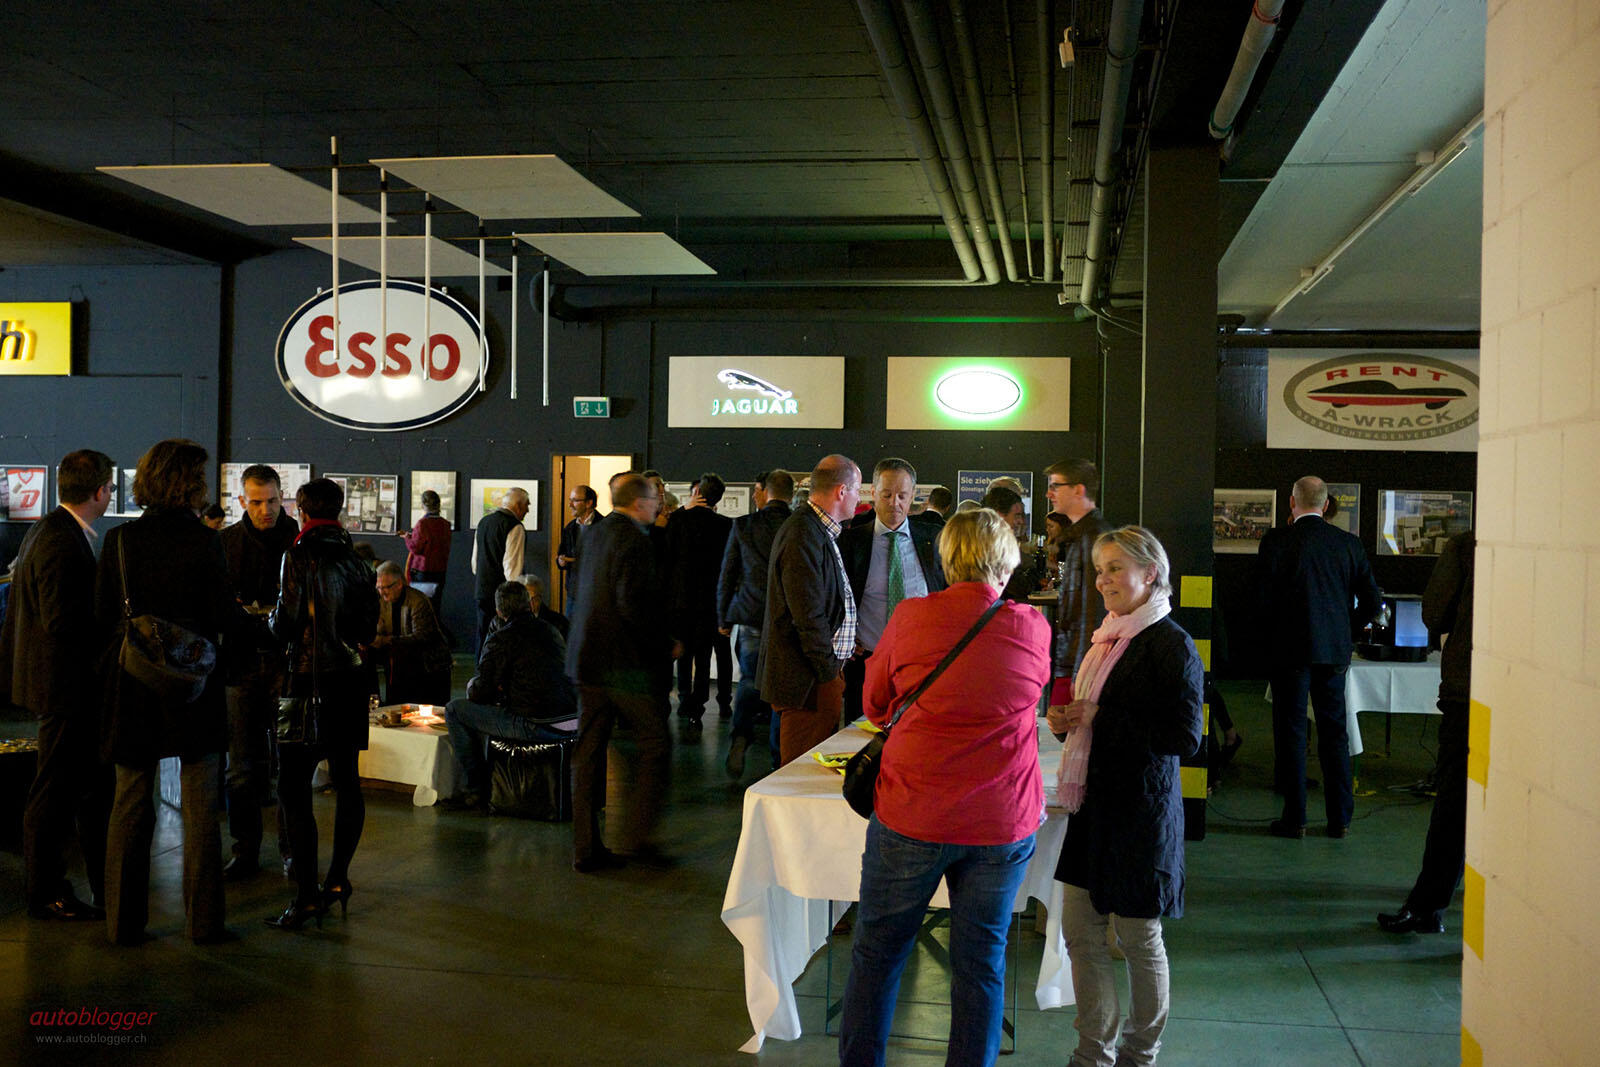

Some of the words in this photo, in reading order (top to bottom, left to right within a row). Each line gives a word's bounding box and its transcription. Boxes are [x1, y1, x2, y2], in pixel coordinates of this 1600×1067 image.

[305, 315, 461, 381] Esso
[1326, 366, 1448, 381] RENT
[711, 398, 799, 416] JAGUAR
[1321, 408, 1453, 428] A-WRACK
